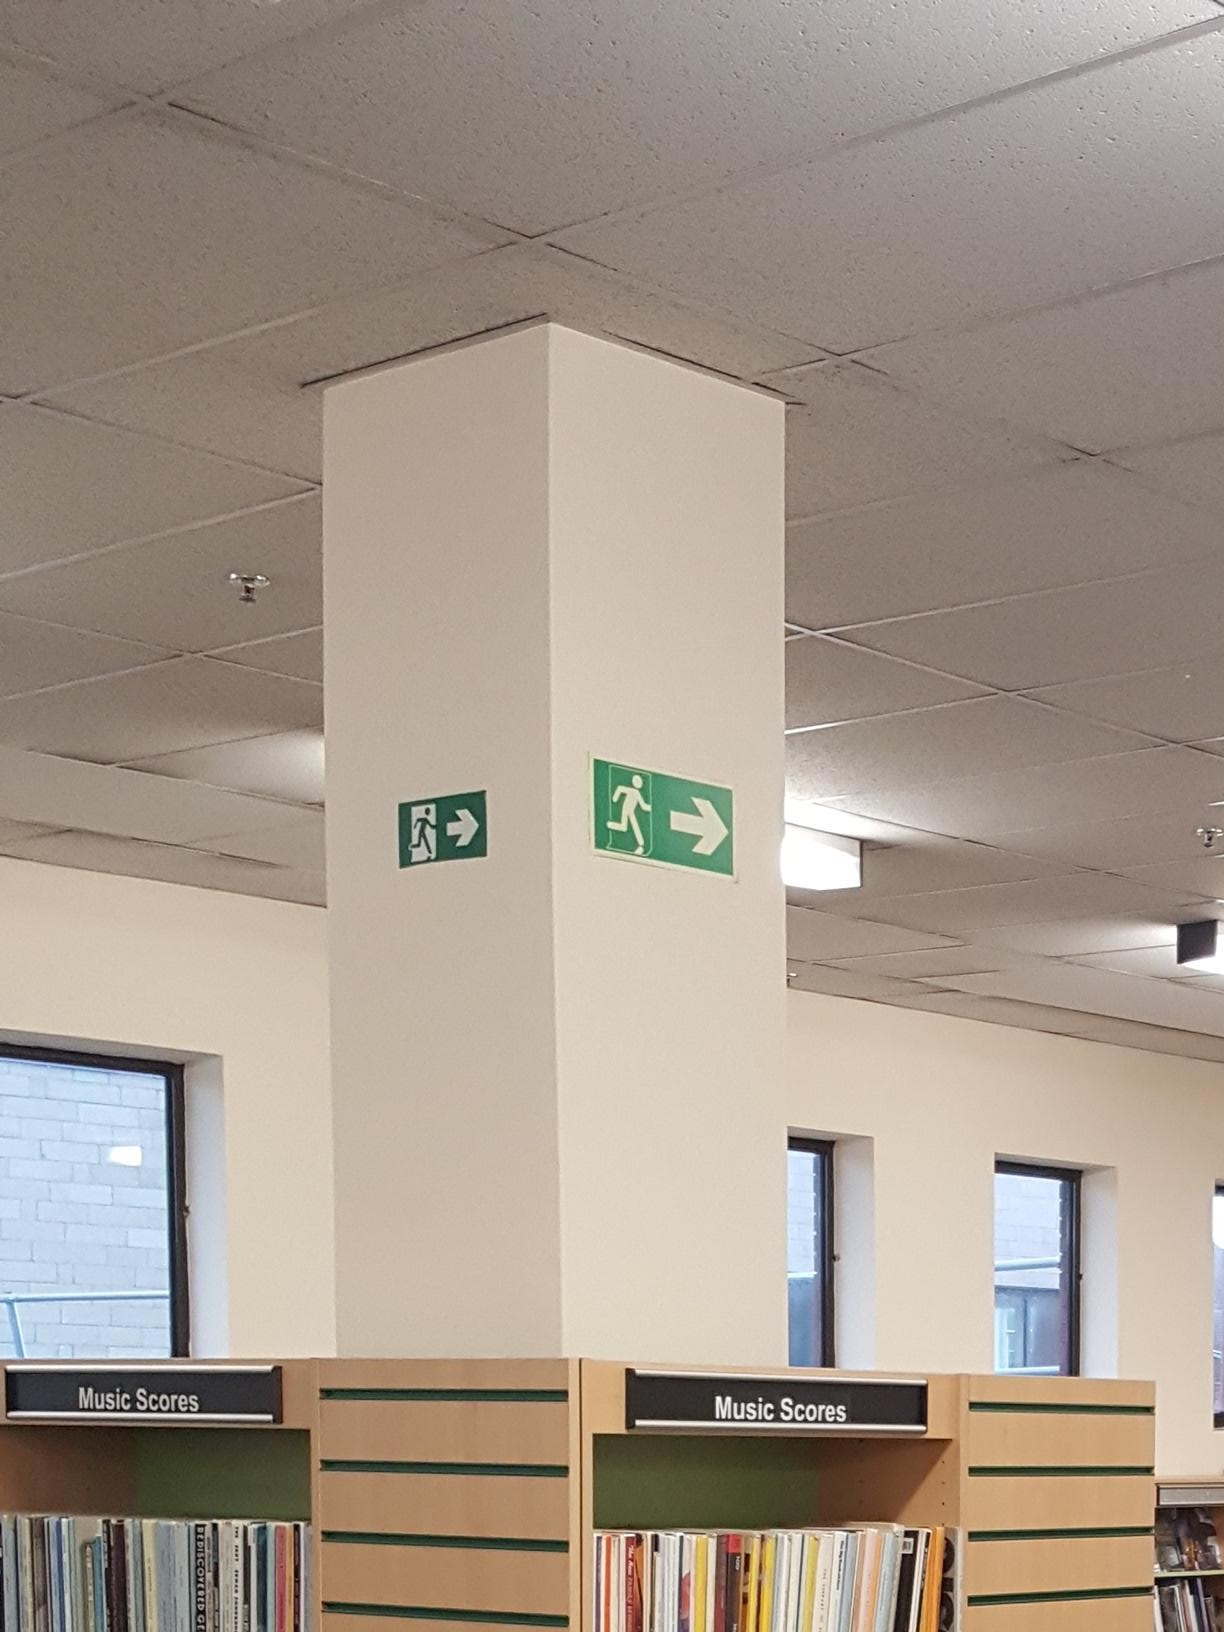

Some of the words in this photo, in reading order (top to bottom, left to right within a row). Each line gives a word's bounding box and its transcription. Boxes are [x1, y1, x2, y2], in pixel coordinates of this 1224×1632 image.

[78, 1386, 131, 1411] Music
[136, 1388, 199, 1413] Scores
[715, 1396, 775, 1422] Music
[780, 1398, 847, 1423] Scores
[196, 1526, 206, 1611] REDISCOVERED
